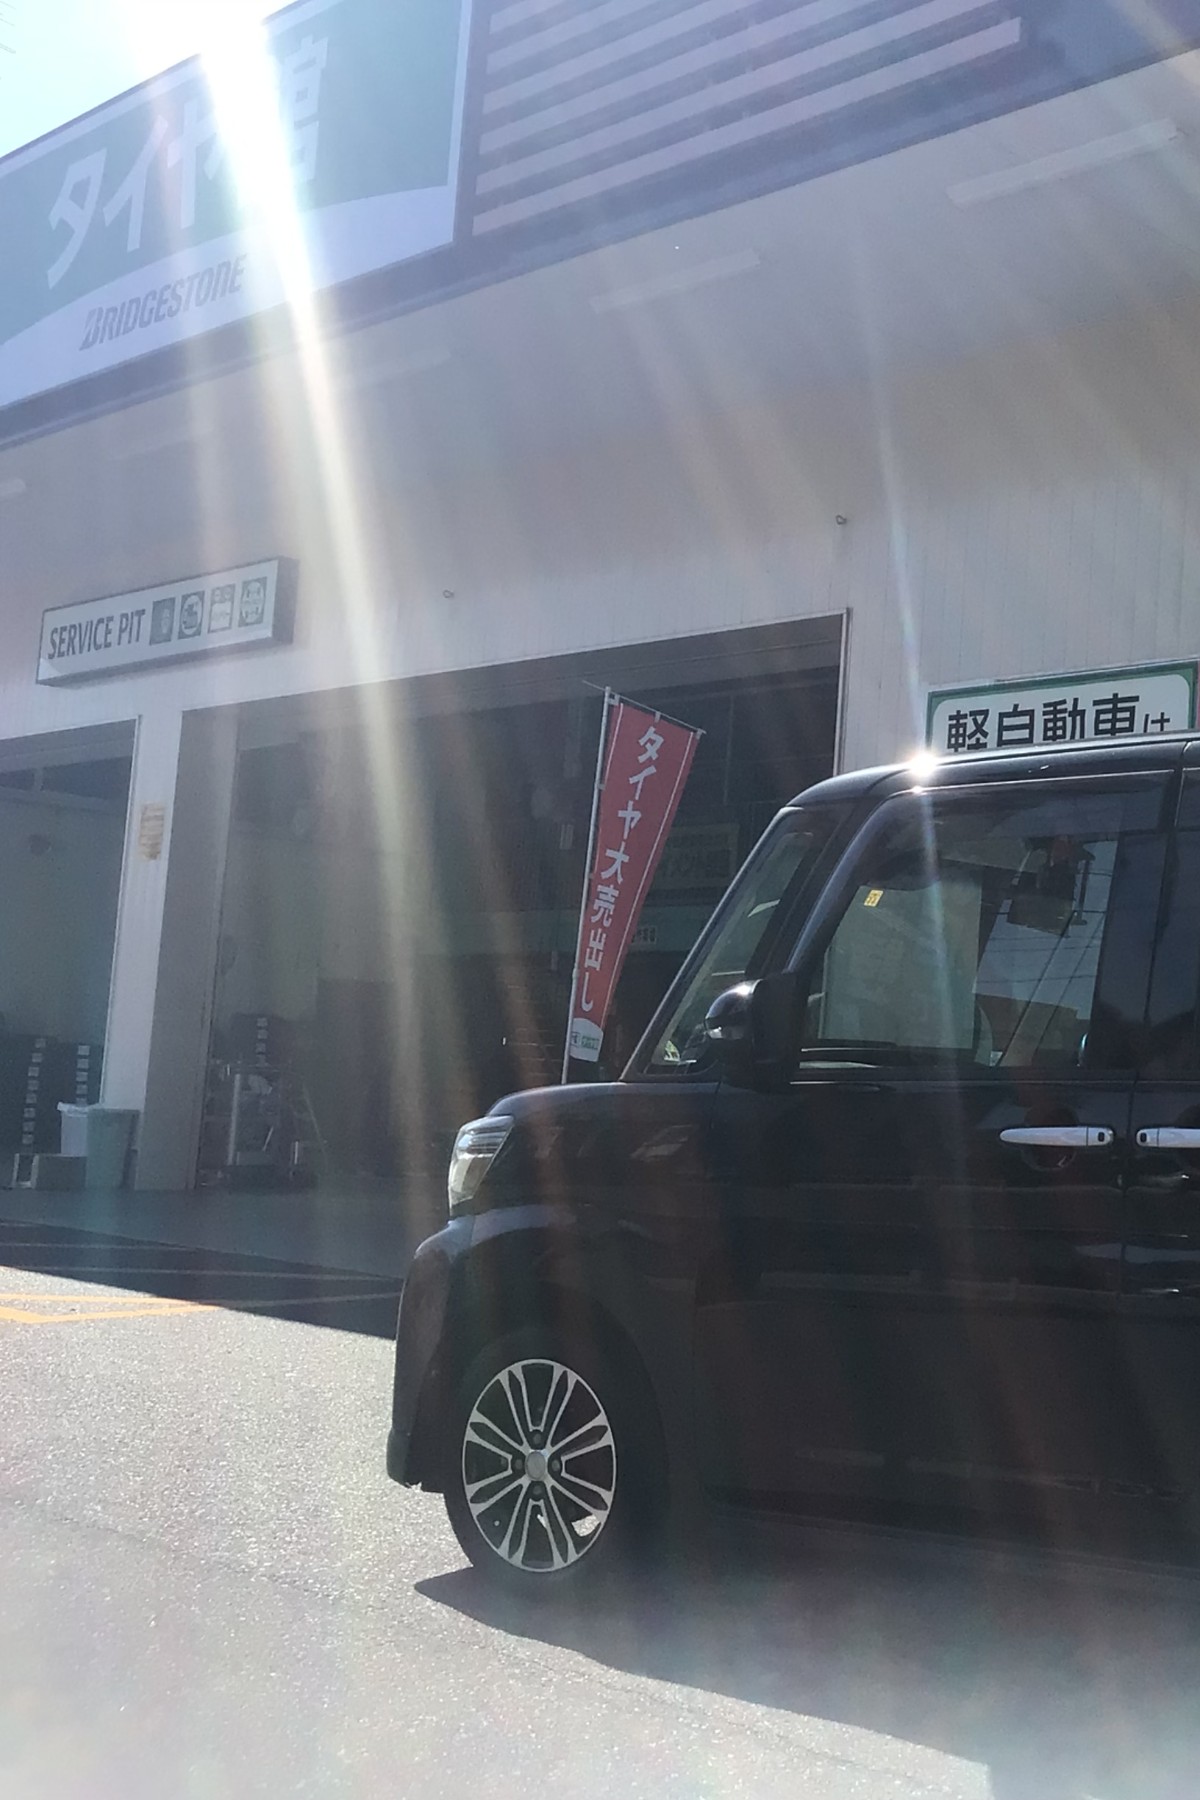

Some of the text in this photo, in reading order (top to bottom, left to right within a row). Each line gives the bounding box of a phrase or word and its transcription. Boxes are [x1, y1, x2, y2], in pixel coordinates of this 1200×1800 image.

[79, 253, 247, 351] BRIDGESTONE
[48, 608, 146, 660] SERVICE PIT
[581, 725, 665, 1013] タイヤ大売出し
